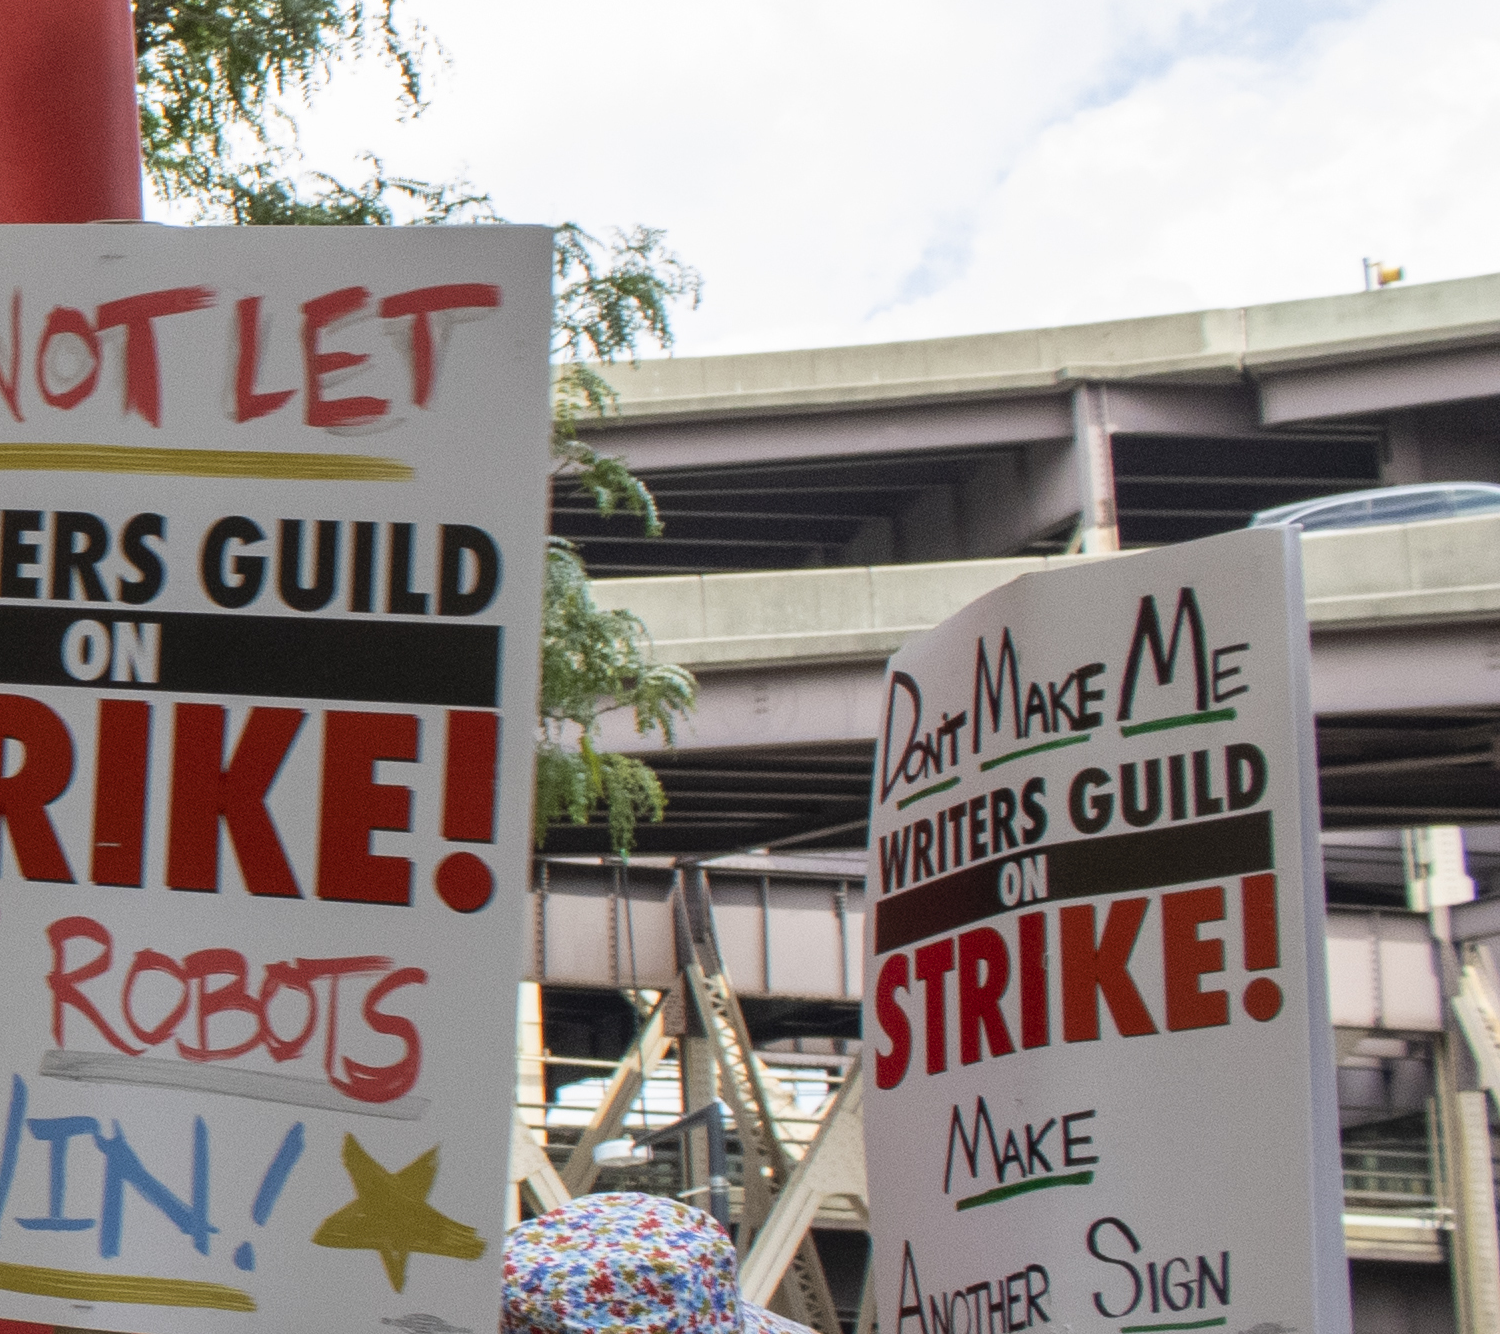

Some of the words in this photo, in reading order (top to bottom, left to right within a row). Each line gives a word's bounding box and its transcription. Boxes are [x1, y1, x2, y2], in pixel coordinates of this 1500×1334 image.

[228, 282, 502, 429] LET
[200, 515, 500, 617] GUILD
[61, 619, 161, 685] ON
[878, 776, 1048, 894] WRITERS
[1068, 742, 1268, 835] GUILD
[999, 853, 1048, 909] ON
[44, 915, 430, 1105] ROBOTS
[874, 872, 1284, 1090] STRIKE!
